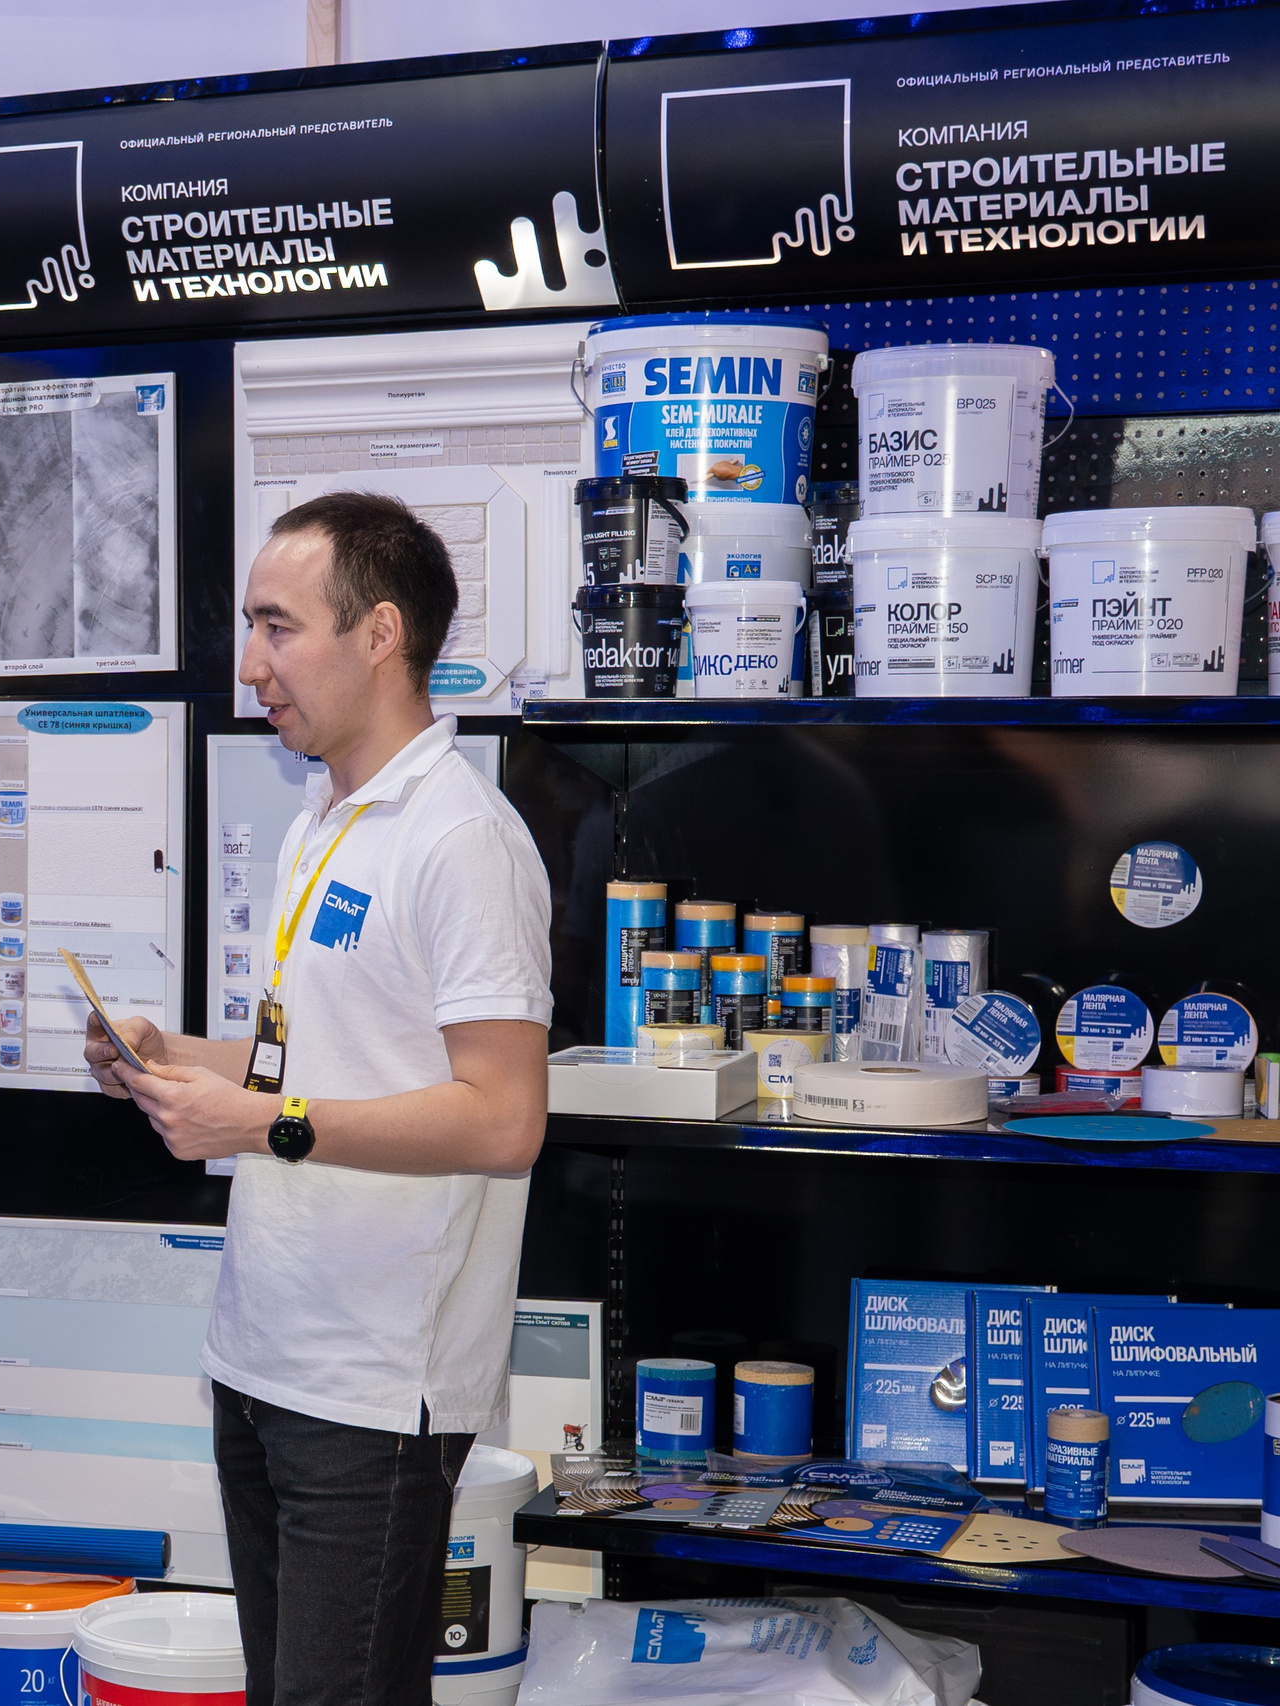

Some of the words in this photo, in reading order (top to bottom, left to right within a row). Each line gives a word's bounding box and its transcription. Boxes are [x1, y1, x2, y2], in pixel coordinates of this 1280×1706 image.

[896, 69, 999, 88] ОФИЦИАЛЬНЫЙ
[1003, 60, 1111, 80] РЕГИОНАЛЬНЫЙ
[1116, 52, 1231, 71] ПРЕДСТАВИТЕЛЬ
[120, 132, 204, 149] ОФИЦИАЛЬНЫЙ
[208, 124, 296, 142] РЕГИОНАЛЬНЫЙ
[300, 118, 393, 134] ПРЕДСТАВИТЕЛЬ
[898, 120, 1028, 147] КОМПАНИЯ
[895, 142, 1226, 192] СТРОИТЕЛЬНЫЕ
[121, 178, 228, 203] КОМПАНИЯ
[898, 185, 1149, 226] МАТЕРИАЛЫ
[121, 198, 394, 243] СТРОИТЕЛЬНЫЕ
[900, 232, 928, 256] И
[935, 215, 1206, 254] ТЕХНОЛОГИИ
[126, 237, 336, 274] МАТЕРИАЛЫ
[132, 279, 159, 302] И
[162, 263, 388, 299] ТЕХНОЛОГИИ
[644, 357, 782, 396] SEMIN
[42, 383, 78, 391] эффектов
[388, 391, 426, 399] Полиуретан
[957, 398, 974, 409] BP
[975, 398, 996, 409] 025
[661, 404, 763, 425] SEM-MURALE
[666, 426, 684, 438] КЛЕЙ
[686, 428, 701, 439] ДЛЯ
[370, 443, 395, 451] Плитка,
[396, 442, 442, 450] керамогранит,
[714, 437, 752, 449] ПОКРЫТИЙ
[869, 429, 938, 454] БАЗИС
[869, 454, 920, 470] ПРАЙМЕР
[543, 469, 578, 477] Пенопласт
[254, 479, 297, 487] Дюрополимер
[976, 574, 997, 584] SCP
[999, 574, 1013, 584] 150
[1187, 568, 1206, 578] PFP
[1208, 568, 1223, 578] 020
[888, 602, 962, 621] КОЛОР
[1092, 591, 1172, 618] ПЭЙНТ
[888, 622, 944, 635] ПРАЙМЕР
[947, 623, 968, 634] 150
[1092, 617, 1154, 631] ПРАЙМЕР
[1157, 619, 1183, 630] 020
[584, 638, 664, 669] redaktor
[96, 660, 119, 668] третий
[120, 659, 136, 667] слой
[734, 655, 778, 671] ДЕКО
[25, 709, 93, 718] Универсальная
[95, 710, 145, 718] шпатлевка
[61, 721, 90, 729] (синяя
[92, 721, 132, 730] крышка)
[1136, 857, 1159, 866] ЛЕНТА
[1137, 848, 1178, 860] МАЛЯРНАЯ
[621, 975, 640, 987] simply
[1082, 1002, 1106, 1010] ЛЕНТА
[1083, 993, 1125, 1003] МАЛЯРНАЯ
[993, 1000, 1028, 1028] МАЛЯРНАЯ
[1184, 1002, 1227, 1011] МАЛЯРНАЯ
[987, 1007, 1008, 1025] ЛЕНТА
[1184, 1011, 1208, 1019] ЛЕНТА
[768, 1075, 792, 1083] СМ
[864, 1295, 909, 1313] ДИСК
[987, 1309, 1021, 1327] ДИС
[1110, 1326, 1155, 1344] ДИСК
[1110, 1344, 1257, 1363] ШЛИФОВАЛЬНЫЙ
[875, 1380, 900, 1395] 225
[1129, 1412, 1155, 1428] 225
[20, 1668, 45, 1693] 20
